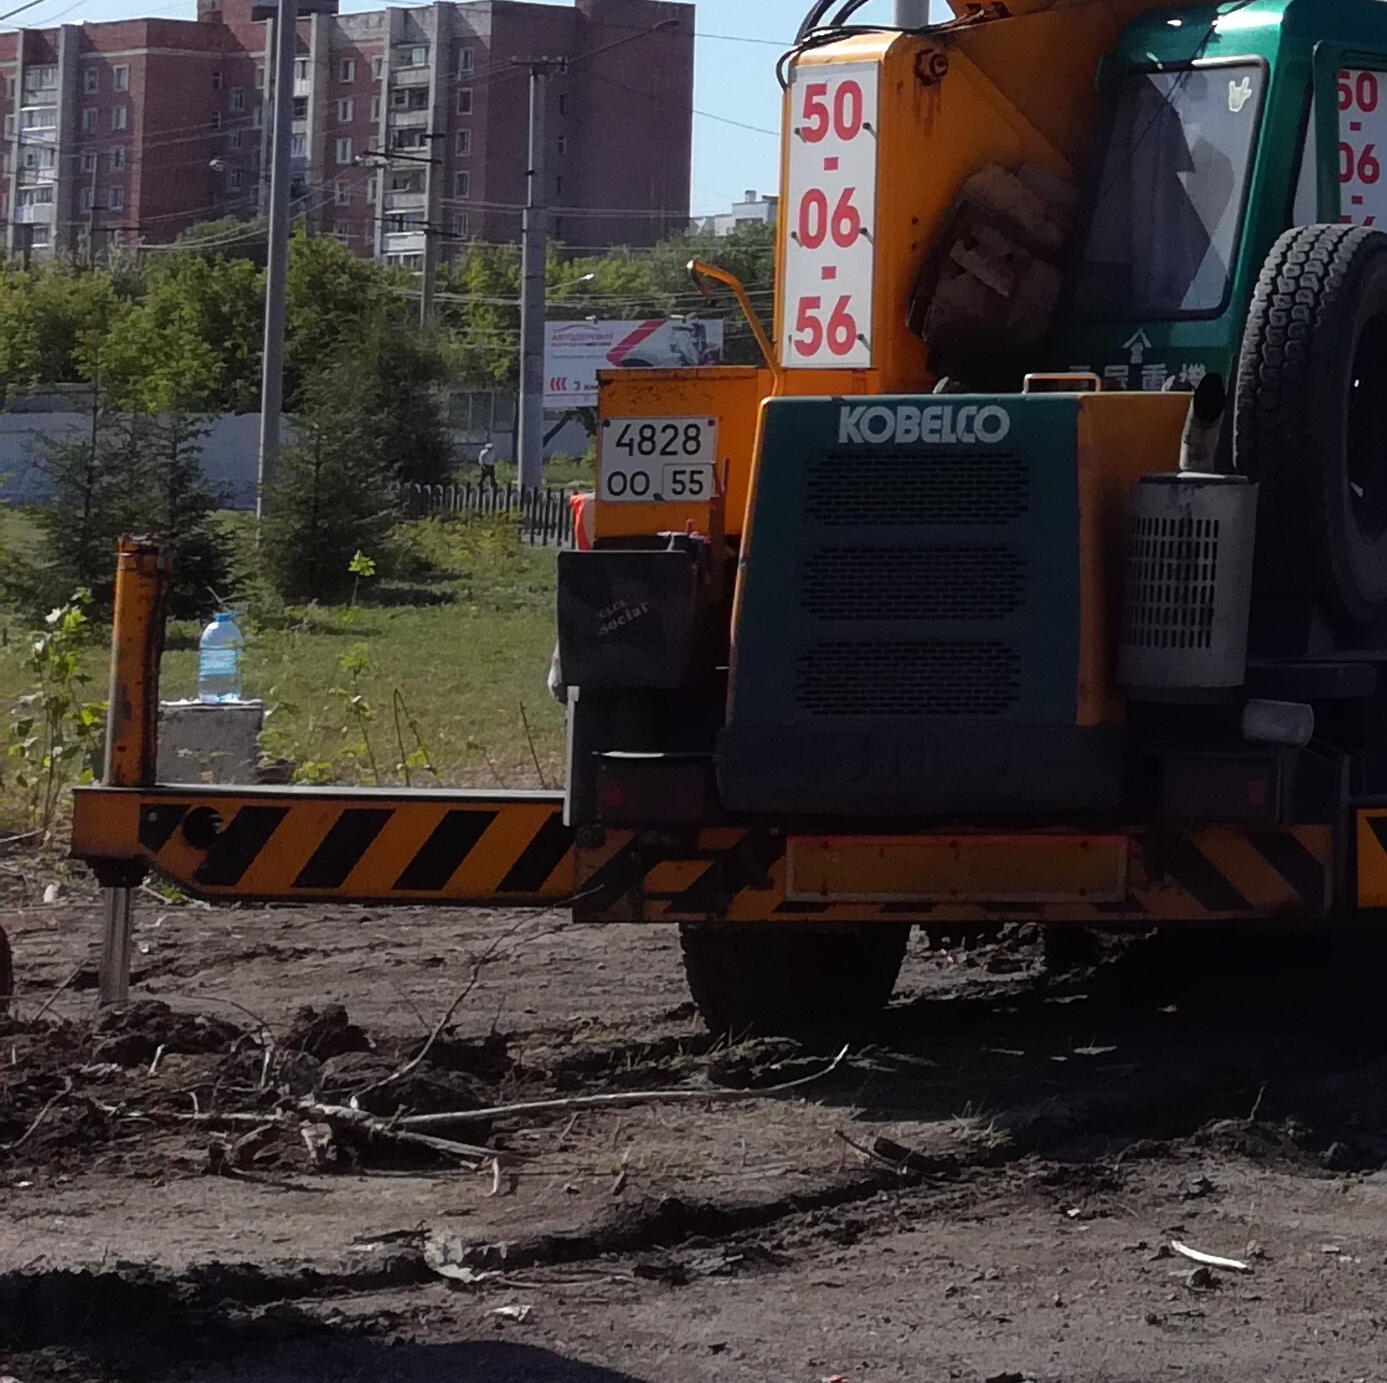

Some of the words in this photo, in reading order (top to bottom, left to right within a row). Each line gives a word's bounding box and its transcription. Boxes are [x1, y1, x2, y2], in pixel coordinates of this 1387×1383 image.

[801, 80, 864, 143] 50
[799, 187, 861, 249] 06
[794, 294, 857, 357] 56
[615, 423, 702, 457] 4828
[838, 405, 1011, 444] KOBELCO
[671, 469, 705, 496] 55
